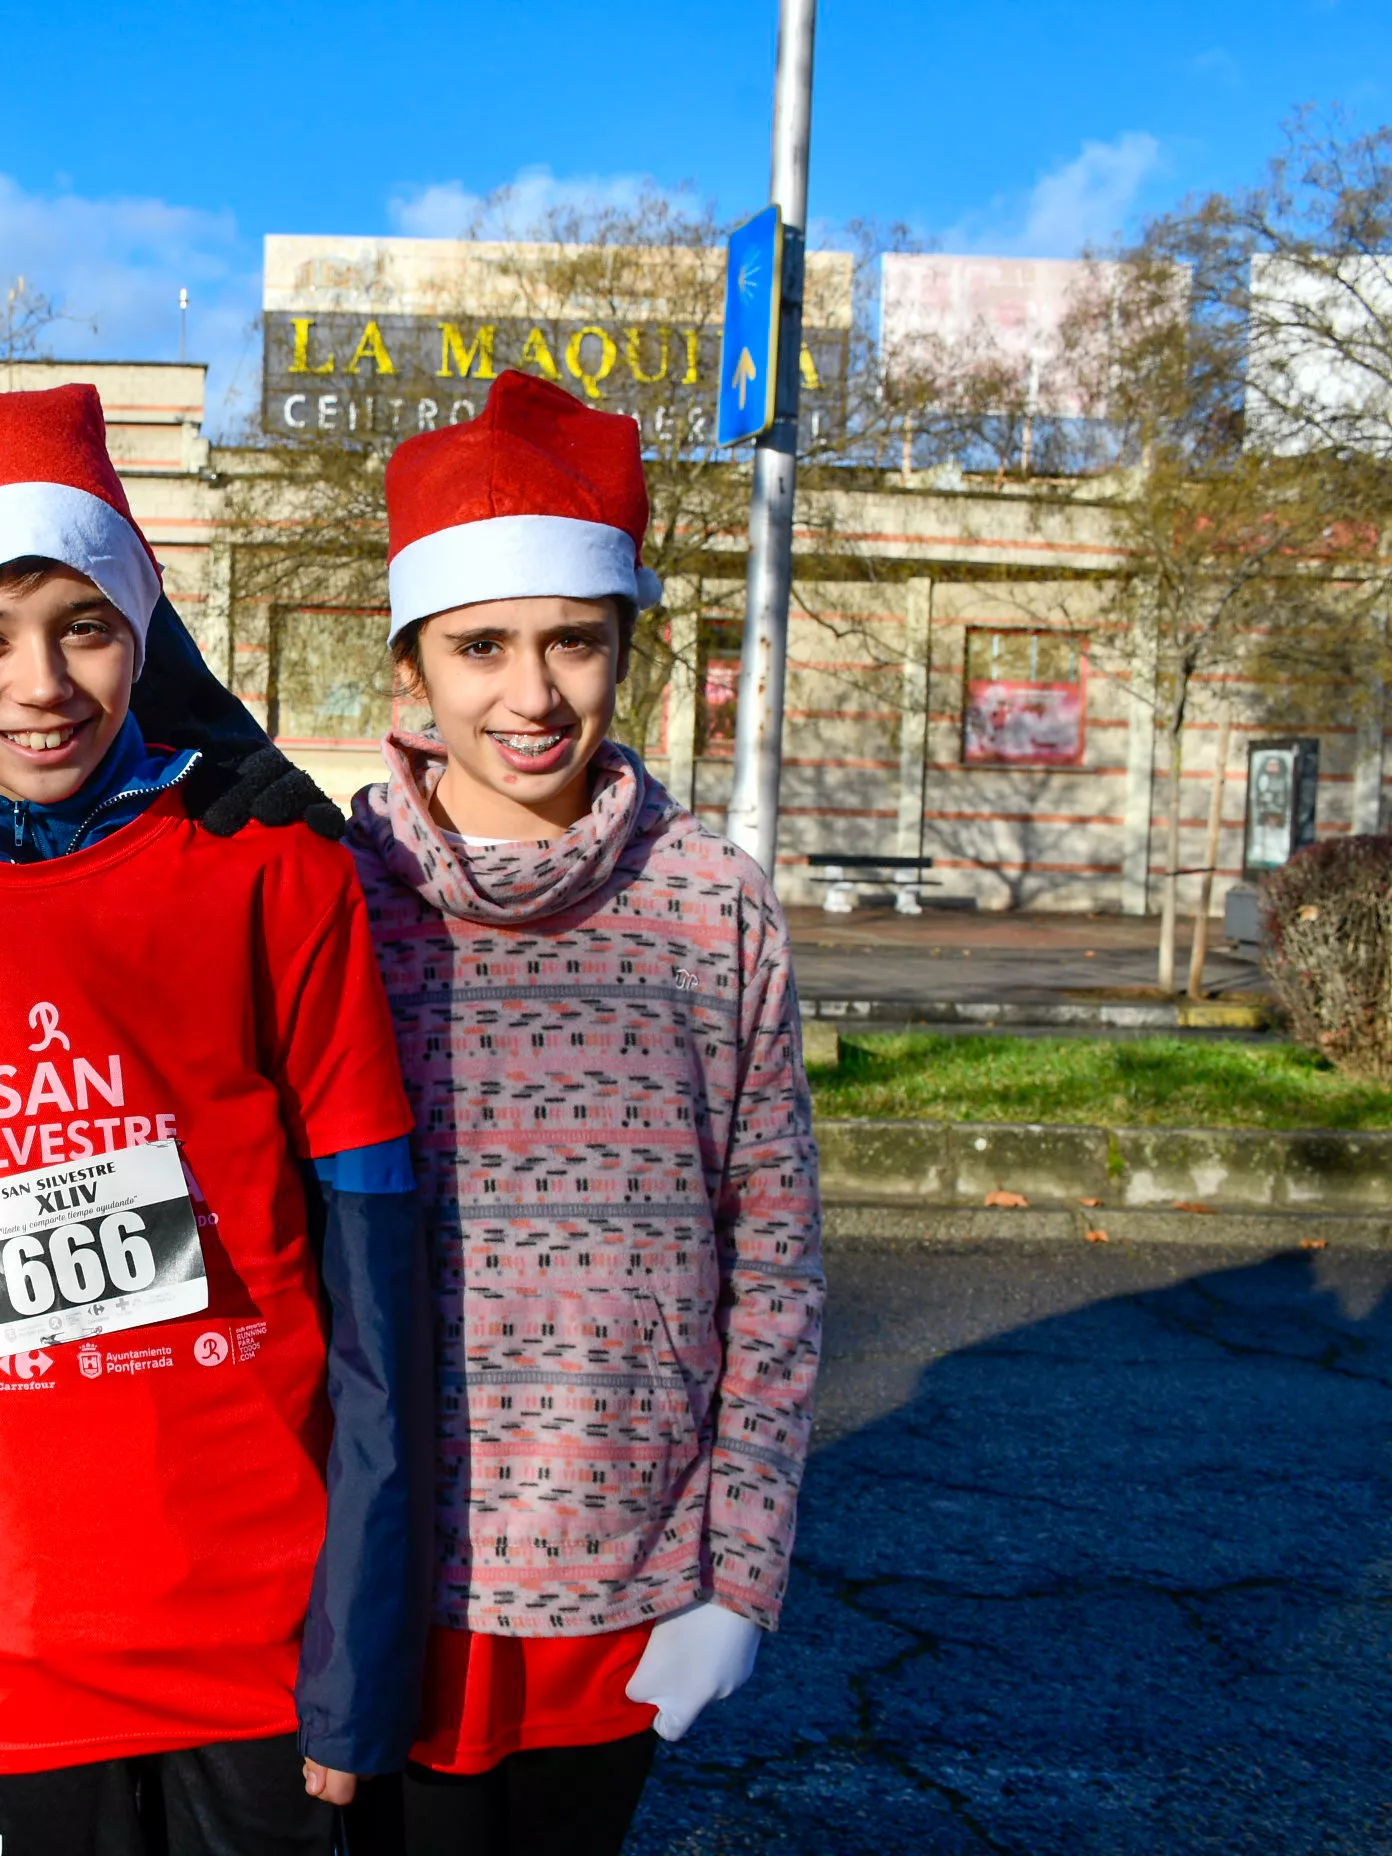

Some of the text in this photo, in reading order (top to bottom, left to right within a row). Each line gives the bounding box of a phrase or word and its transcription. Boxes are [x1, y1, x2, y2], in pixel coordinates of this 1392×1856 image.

[288, 318, 398, 375] LA
[1, 1161, 116, 1199] SAN SILVESTRE
[34, 1181, 98, 1215] XLIV
[29, 1213, 66, 1229] comparte
[67, 1207, 93, 1220] tiempo
[2, 1211, 155, 1316] 666
[106, 1346, 172, 1363] Ayuntamiento
[106, 1356, 174, 1376] Ponferrada
